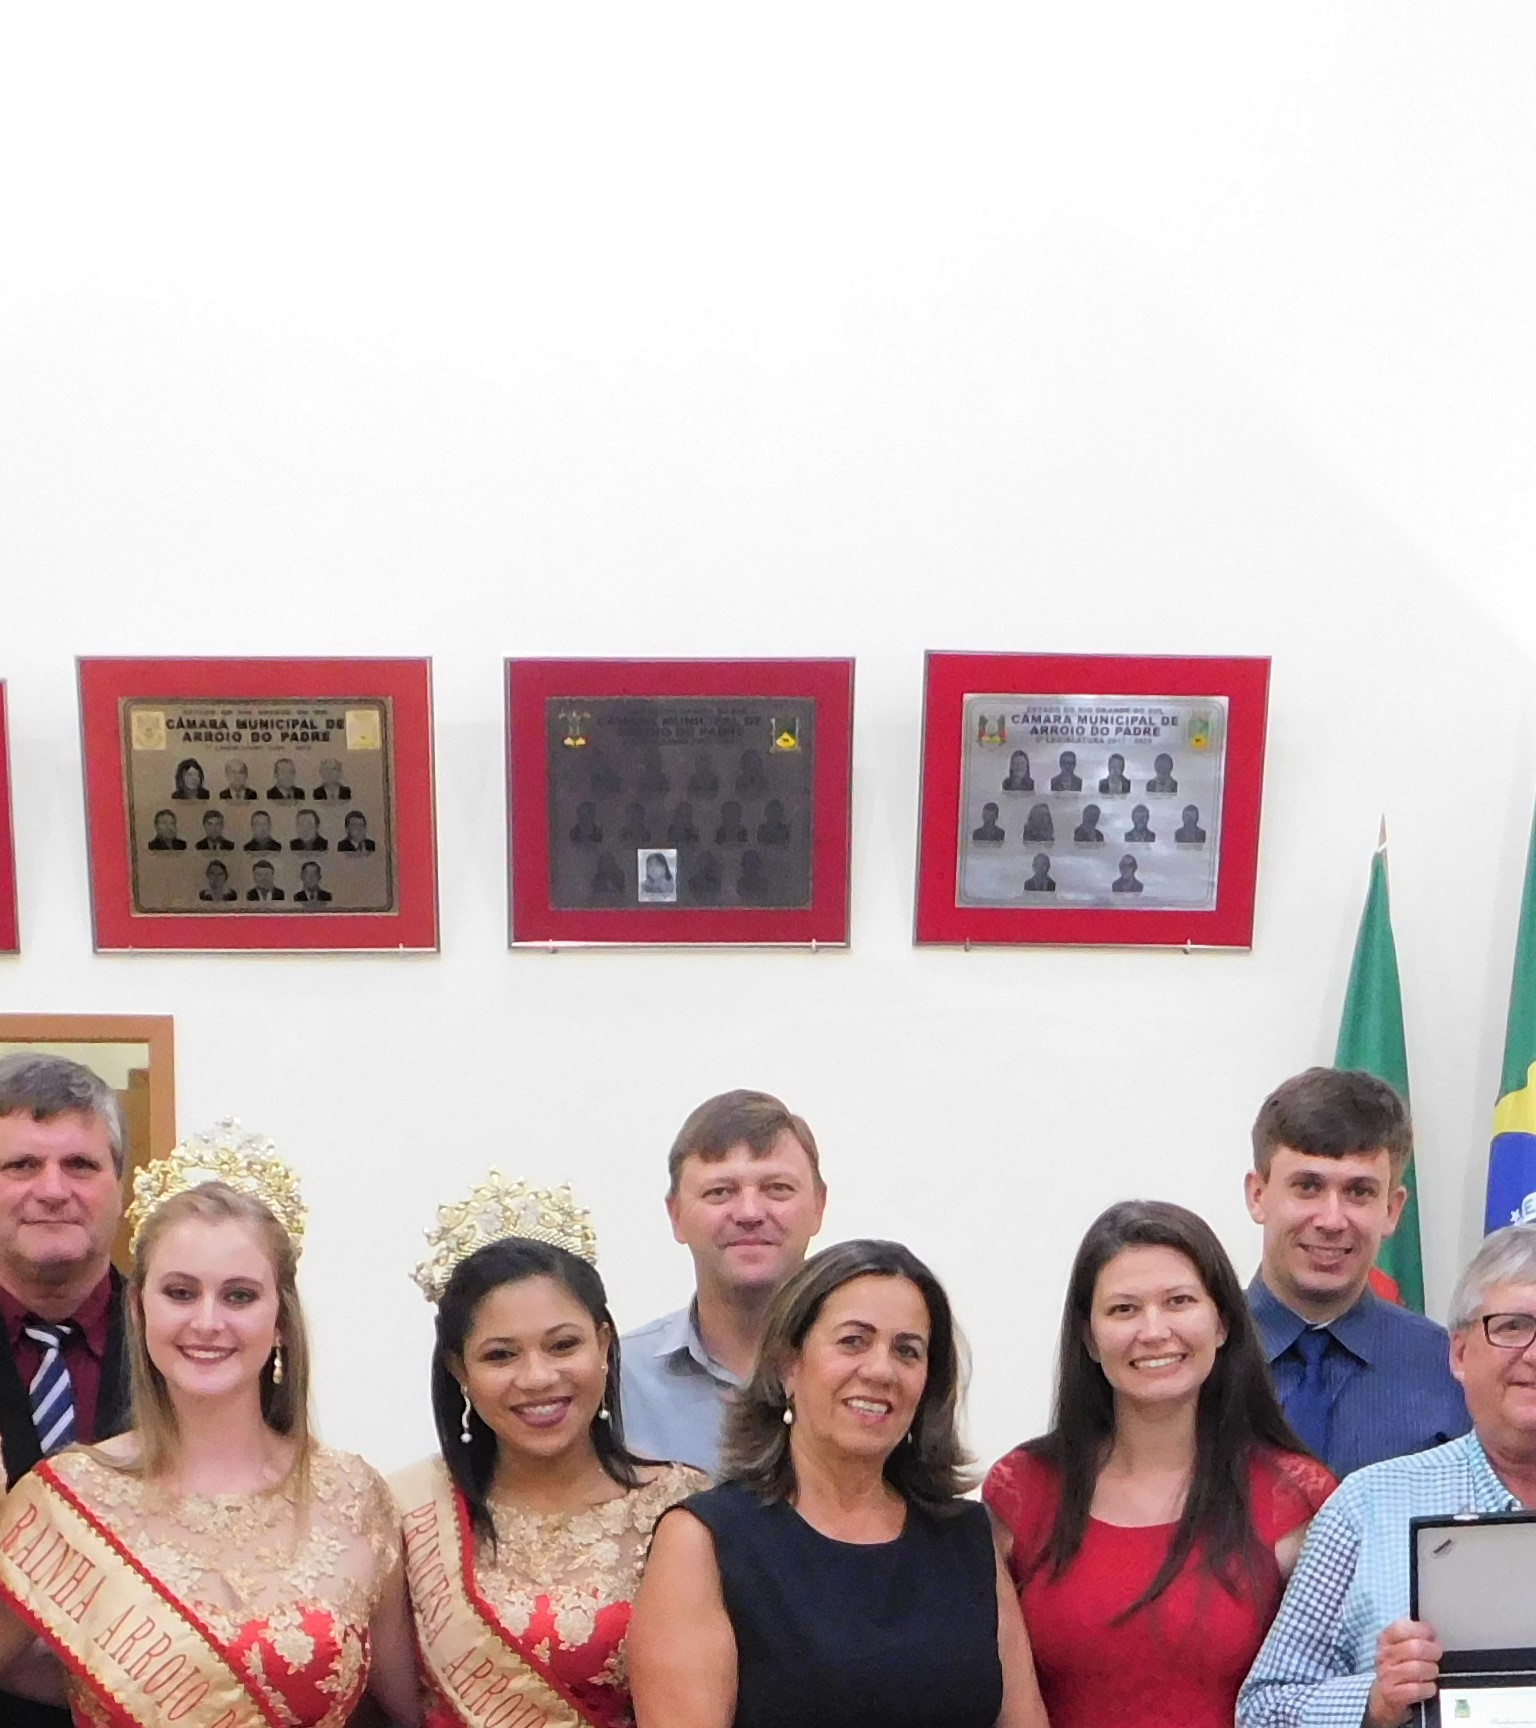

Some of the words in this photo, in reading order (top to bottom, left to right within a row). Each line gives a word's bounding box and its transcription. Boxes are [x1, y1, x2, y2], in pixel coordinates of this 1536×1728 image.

[165, 716, 229, 730] CÂMARA
[235, 718, 318, 730] MUNICIPAL
[325, 718, 345, 730] DE
[1011, 713, 1072, 725] CÂMARA
[1077, 714, 1156, 726] MUNICIPAL
[1161, 715, 1179, 727] DE
[181, 731, 242, 743] ARROIO
[250, 731, 272, 743] DO
[280, 731, 331, 743] PADRE
[1030, 725, 1086, 737] ARROIO
[1090, 726, 1110, 737] DO
[1114, 726, 1162, 738] PADRE
[403, 1501, 455, 1648] PRINCESA
[92, 1604, 210, 1721] ARROIO
